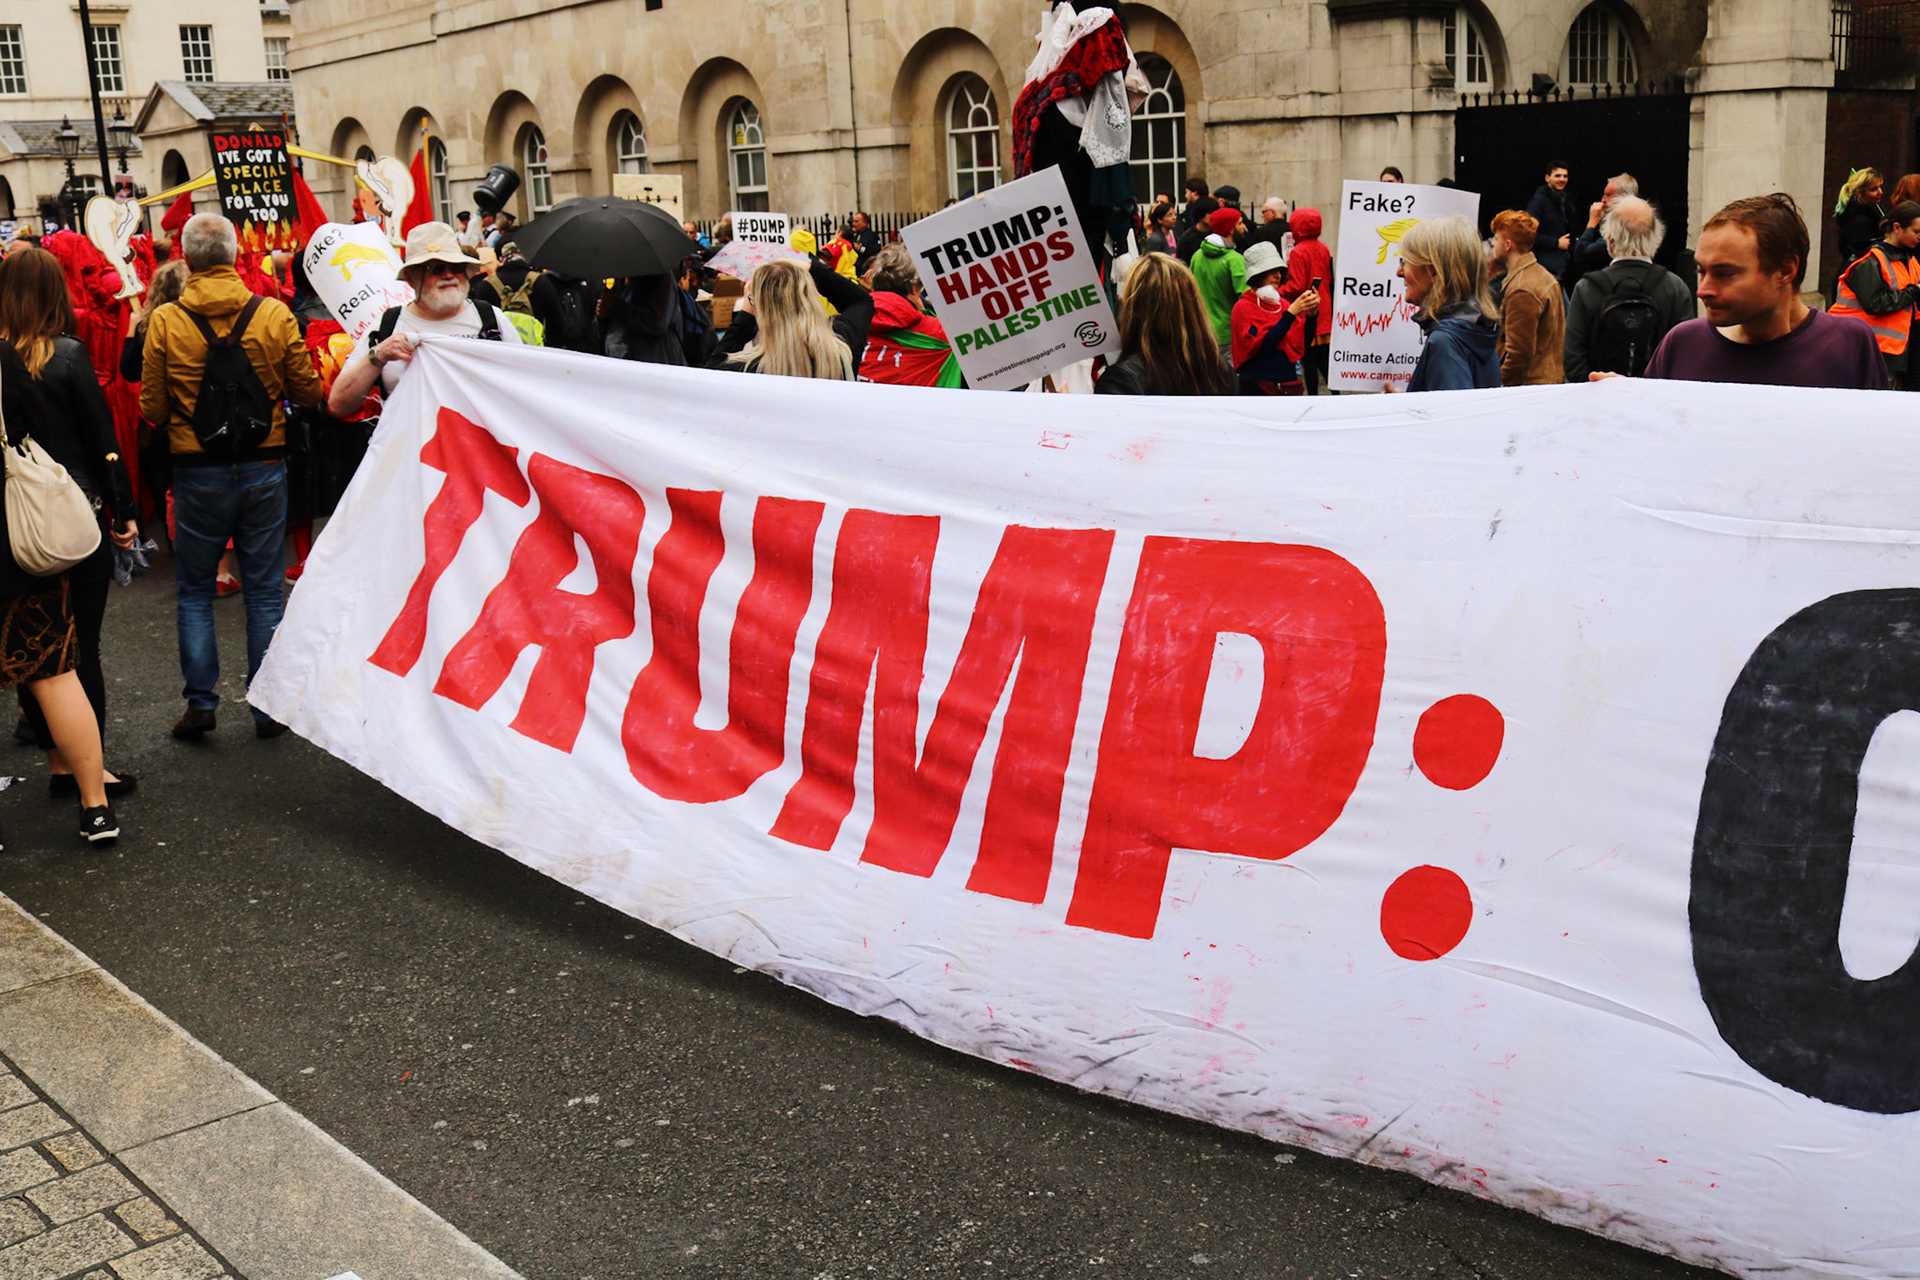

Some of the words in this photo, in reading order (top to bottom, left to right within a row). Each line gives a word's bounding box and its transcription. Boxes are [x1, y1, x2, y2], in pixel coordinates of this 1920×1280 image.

[213, 134, 282, 151] DONALD
[217, 149, 241, 164] I'VE
[245, 149, 272, 163] GOT
[277, 150, 286, 162] A
[223, 164, 286, 179] SPECIAL
[231, 179, 282, 196] PLACE
[225, 195, 254, 209] FOR
[261, 193, 289, 207] YOU
[1349, 191, 1415, 213] Fake?
[249, 207, 278, 221] TOO
[737, 218, 785, 233] #DUMP
[920, 205, 1068, 276] TRUMP:
[305, 228, 344, 275] Fake?
[936, 230, 1075, 306] HANDS
[981, 269, 1052, 321] OFF
[1342, 277, 1397, 298] Real.
[338, 283, 381, 321] Real.
[954, 283, 1101, 356] PALESTINE
[1080, 328, 1101, 342] PSC
[976, 342, 1066, 382] www.palestinecampaign.org
[1333, 350, 1382, 364] Climate
[366, 405, 1505, 961] TRUMP:
